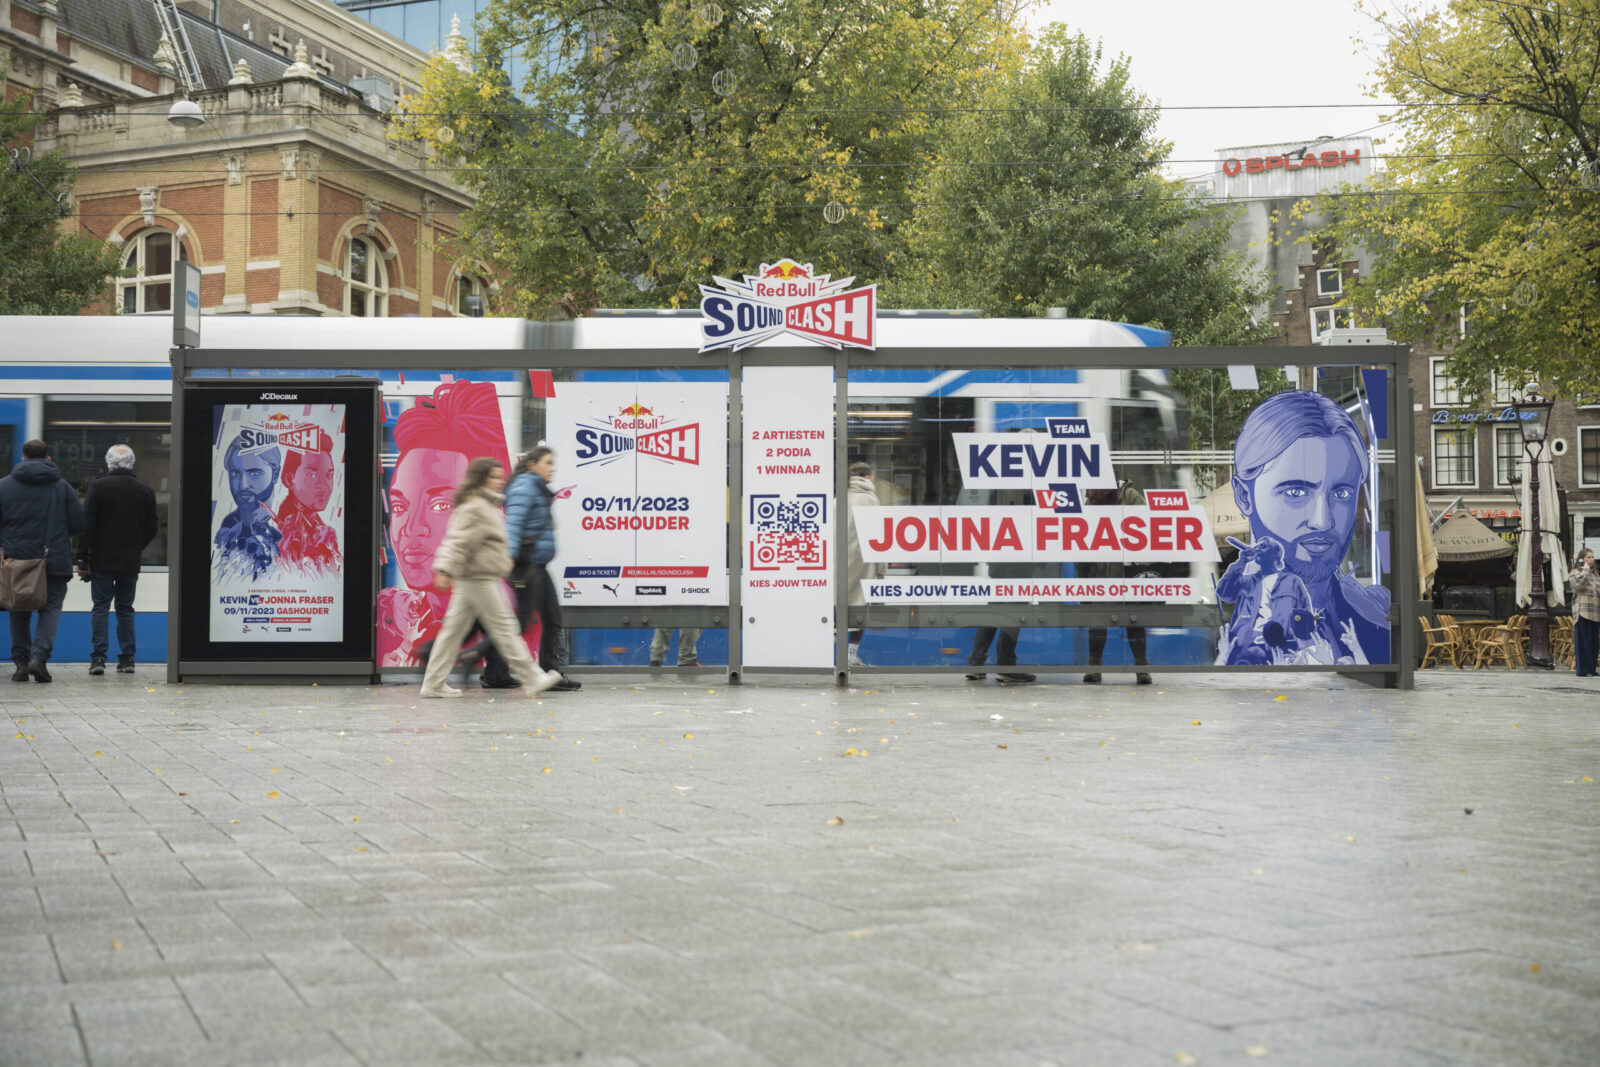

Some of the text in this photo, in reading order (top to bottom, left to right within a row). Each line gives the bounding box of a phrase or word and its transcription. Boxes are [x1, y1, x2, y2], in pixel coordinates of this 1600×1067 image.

[1246, 148, 1360, 174] SPLASH
[756, 283, 816, 296] Red Bull
[704, 296, 868, 340] SOUND CLASH
[614, 418, 658, 430] Red Bull
[1054, 424, 1085, 434] TEAM
[240, 428, 318, 450] SOUND CLASH
[752, 430, 825, 440] 2 ARTIESTEN
[576, 428, 696, 461] SOUND CLASH
[766, 448, 812, 457] 2 PODIA
[969, 444, 1100, 478] KEVIN
[756, 465, 820, 474] 1 WINNAAR
[582, 496, 690, 512] 09/11/2023
[1042, 491, 1074, 507] VS.
[1152, 496, 1184, 506] TEAM
[1481, 508, 1522, 518] WAA
[582, 516, 690, 530] GASHOUDER
[868, 516, 1204, 552] JONNA FRASER
[750, 580, 827, 588] KIES JOUW TEAM
[870, 584, 1192, 597] KIES JOUW TEAM EN MAAK KANS OP TICKETS
[220, 596, 248, 604] KEVIN
[265, 596, 296, 604] JONNA
[299, 596, 334, 604] FRASER
[224, 607, 329, 615] 09/11/2023 GASHOUDER
